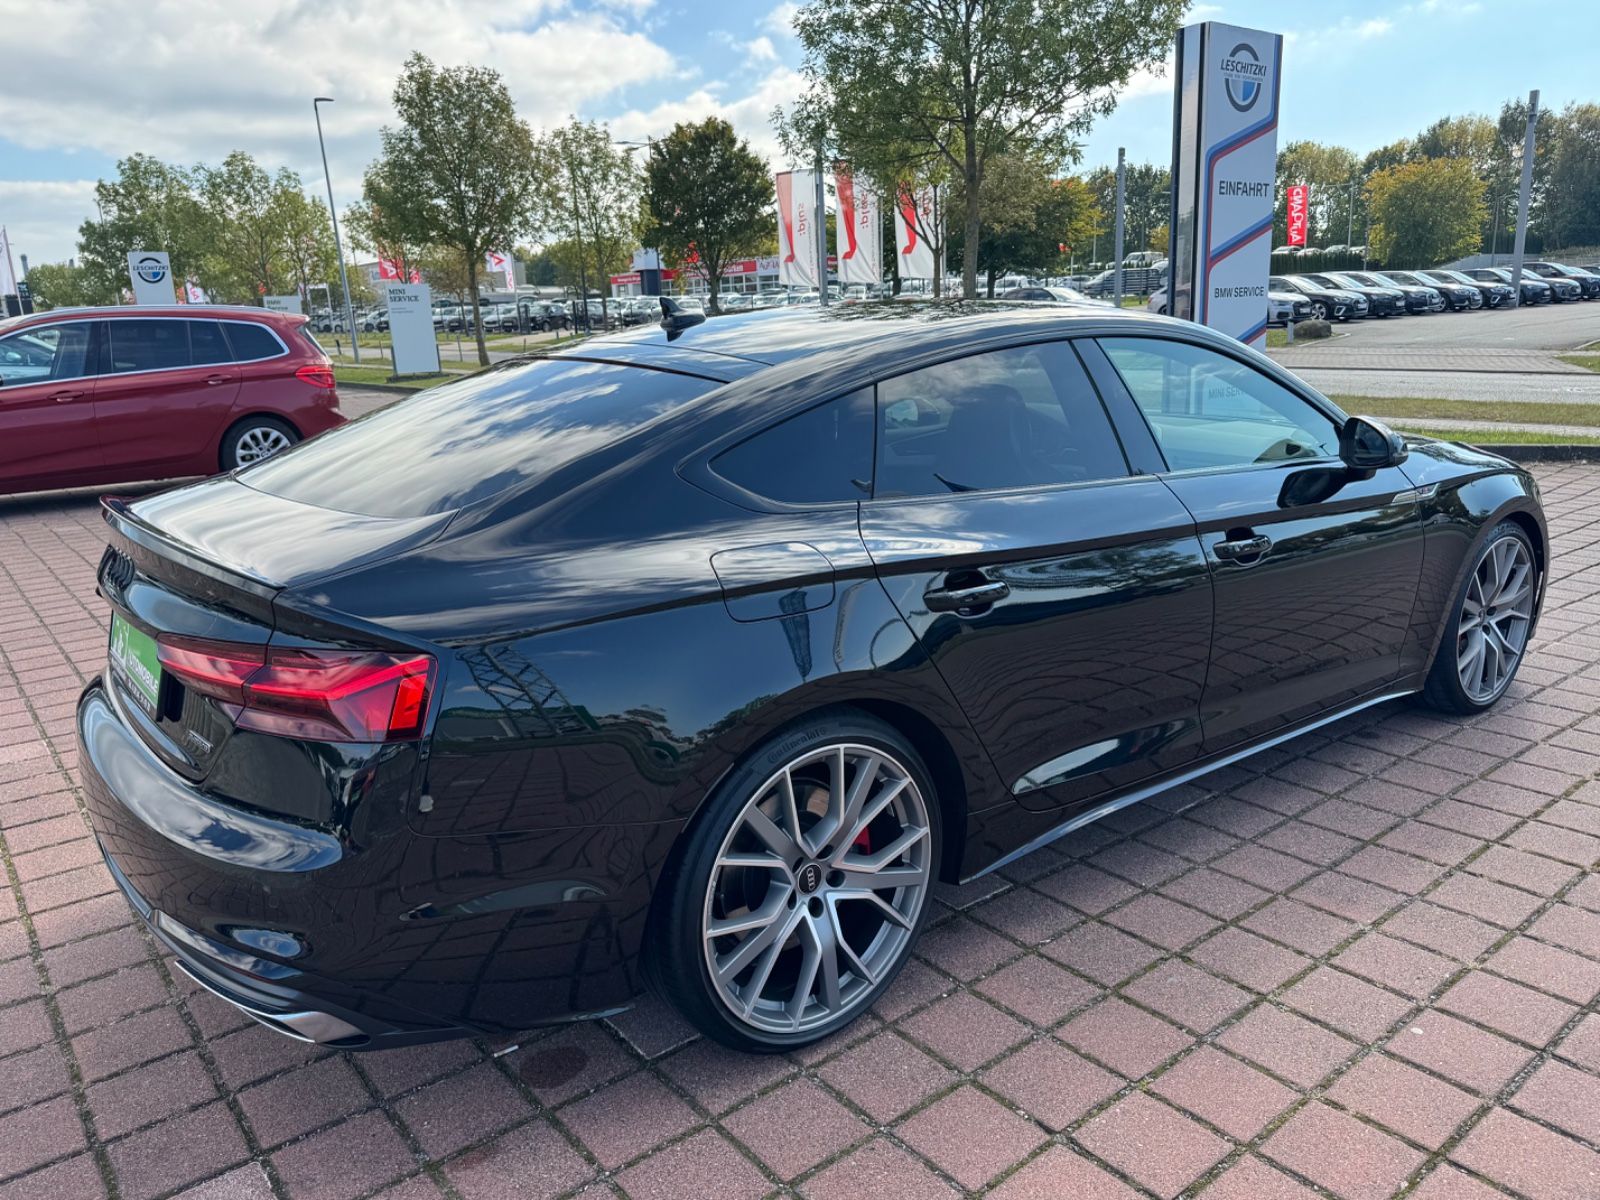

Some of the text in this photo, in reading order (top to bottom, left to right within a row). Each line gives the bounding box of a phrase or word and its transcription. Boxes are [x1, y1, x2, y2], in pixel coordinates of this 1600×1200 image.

[1220, 58, 1267, 77] LESCHITZKI
[1218, 180, 1270, 197] EINFAHRT
[1214, 286, 1265, 298] BMW SERVICE
